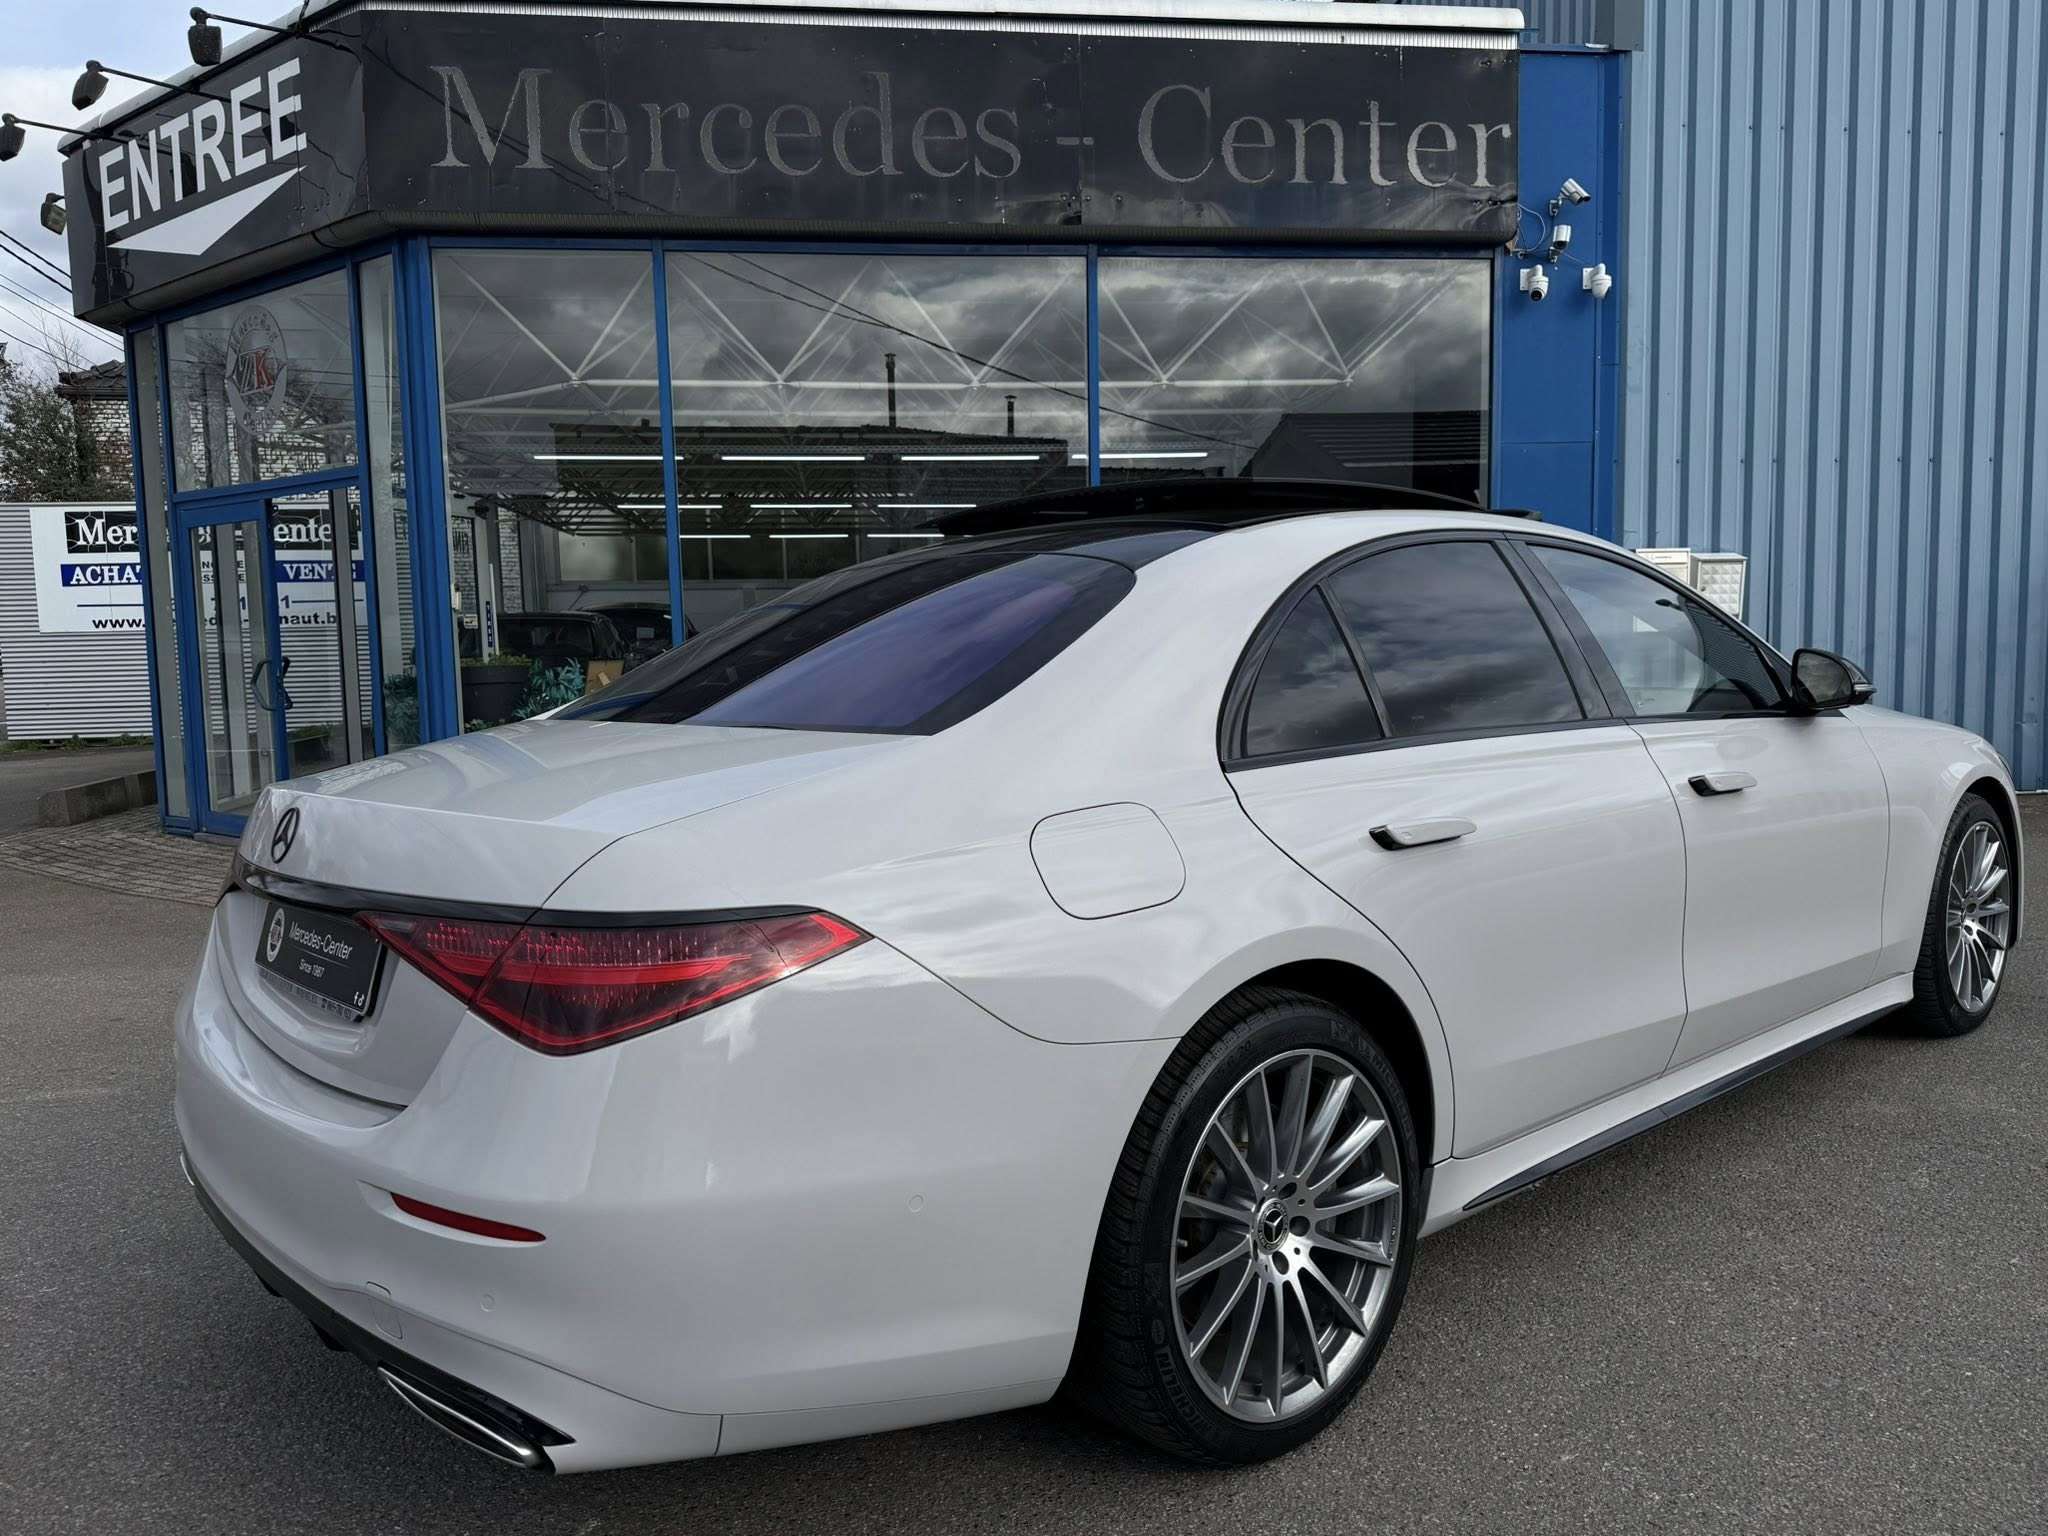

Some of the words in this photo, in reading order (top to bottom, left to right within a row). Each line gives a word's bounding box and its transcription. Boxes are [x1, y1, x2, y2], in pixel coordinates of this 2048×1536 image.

[99, 57, 307, 233] ENTREE
[428, 64, 1022, 179] Mercedes
[1137, 84, 1513, 189] Center
[273, 518, 333, 543] ente
[70, 564, 143, 586] ACHA
[289, 921, 353, 959] Mercedes-Center
